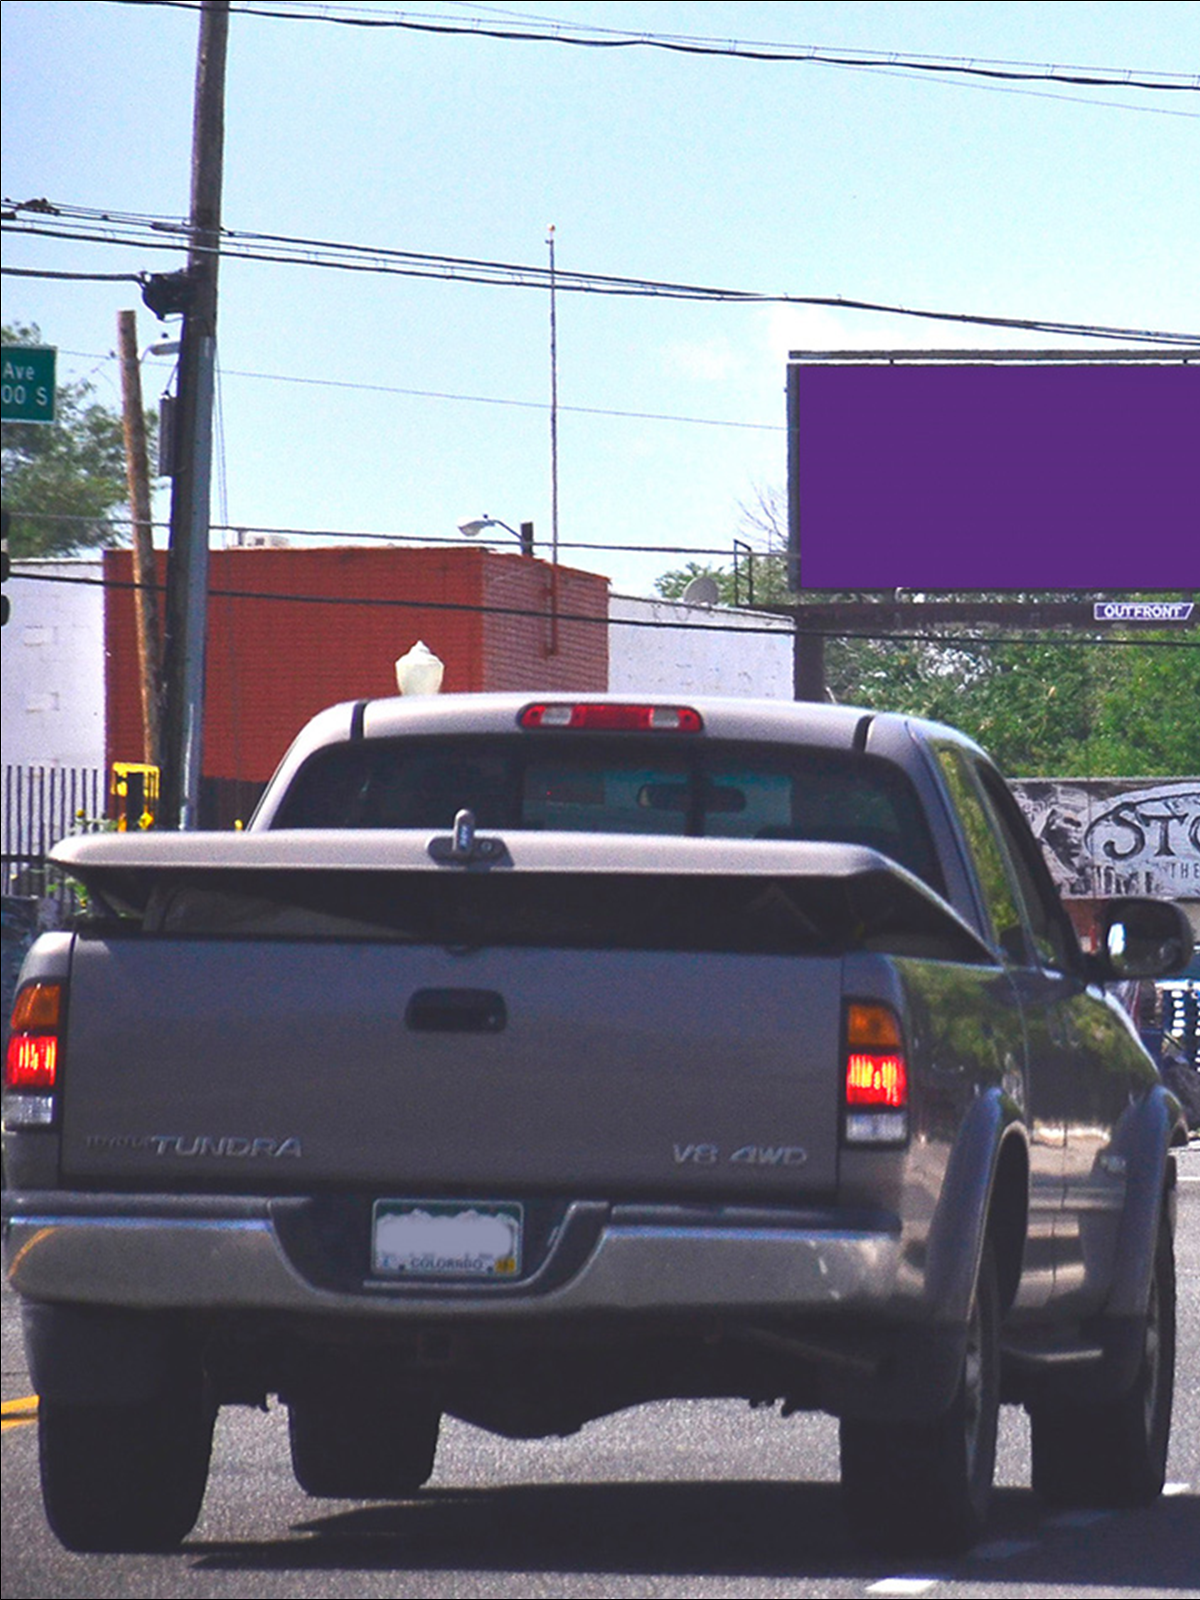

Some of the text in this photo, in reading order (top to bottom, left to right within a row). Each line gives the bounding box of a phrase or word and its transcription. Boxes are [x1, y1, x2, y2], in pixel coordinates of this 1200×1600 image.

[2, 361, 35, 380] Ave
[36, 386, 48, 406] S
[1104, 604, 1183, 619] OUTFRONT
[1170, 862, 1200, 879] THE
[151, 1134, 302, 1158] TUNDRA
[672, 1143, 808, 1165] V8 4WD
